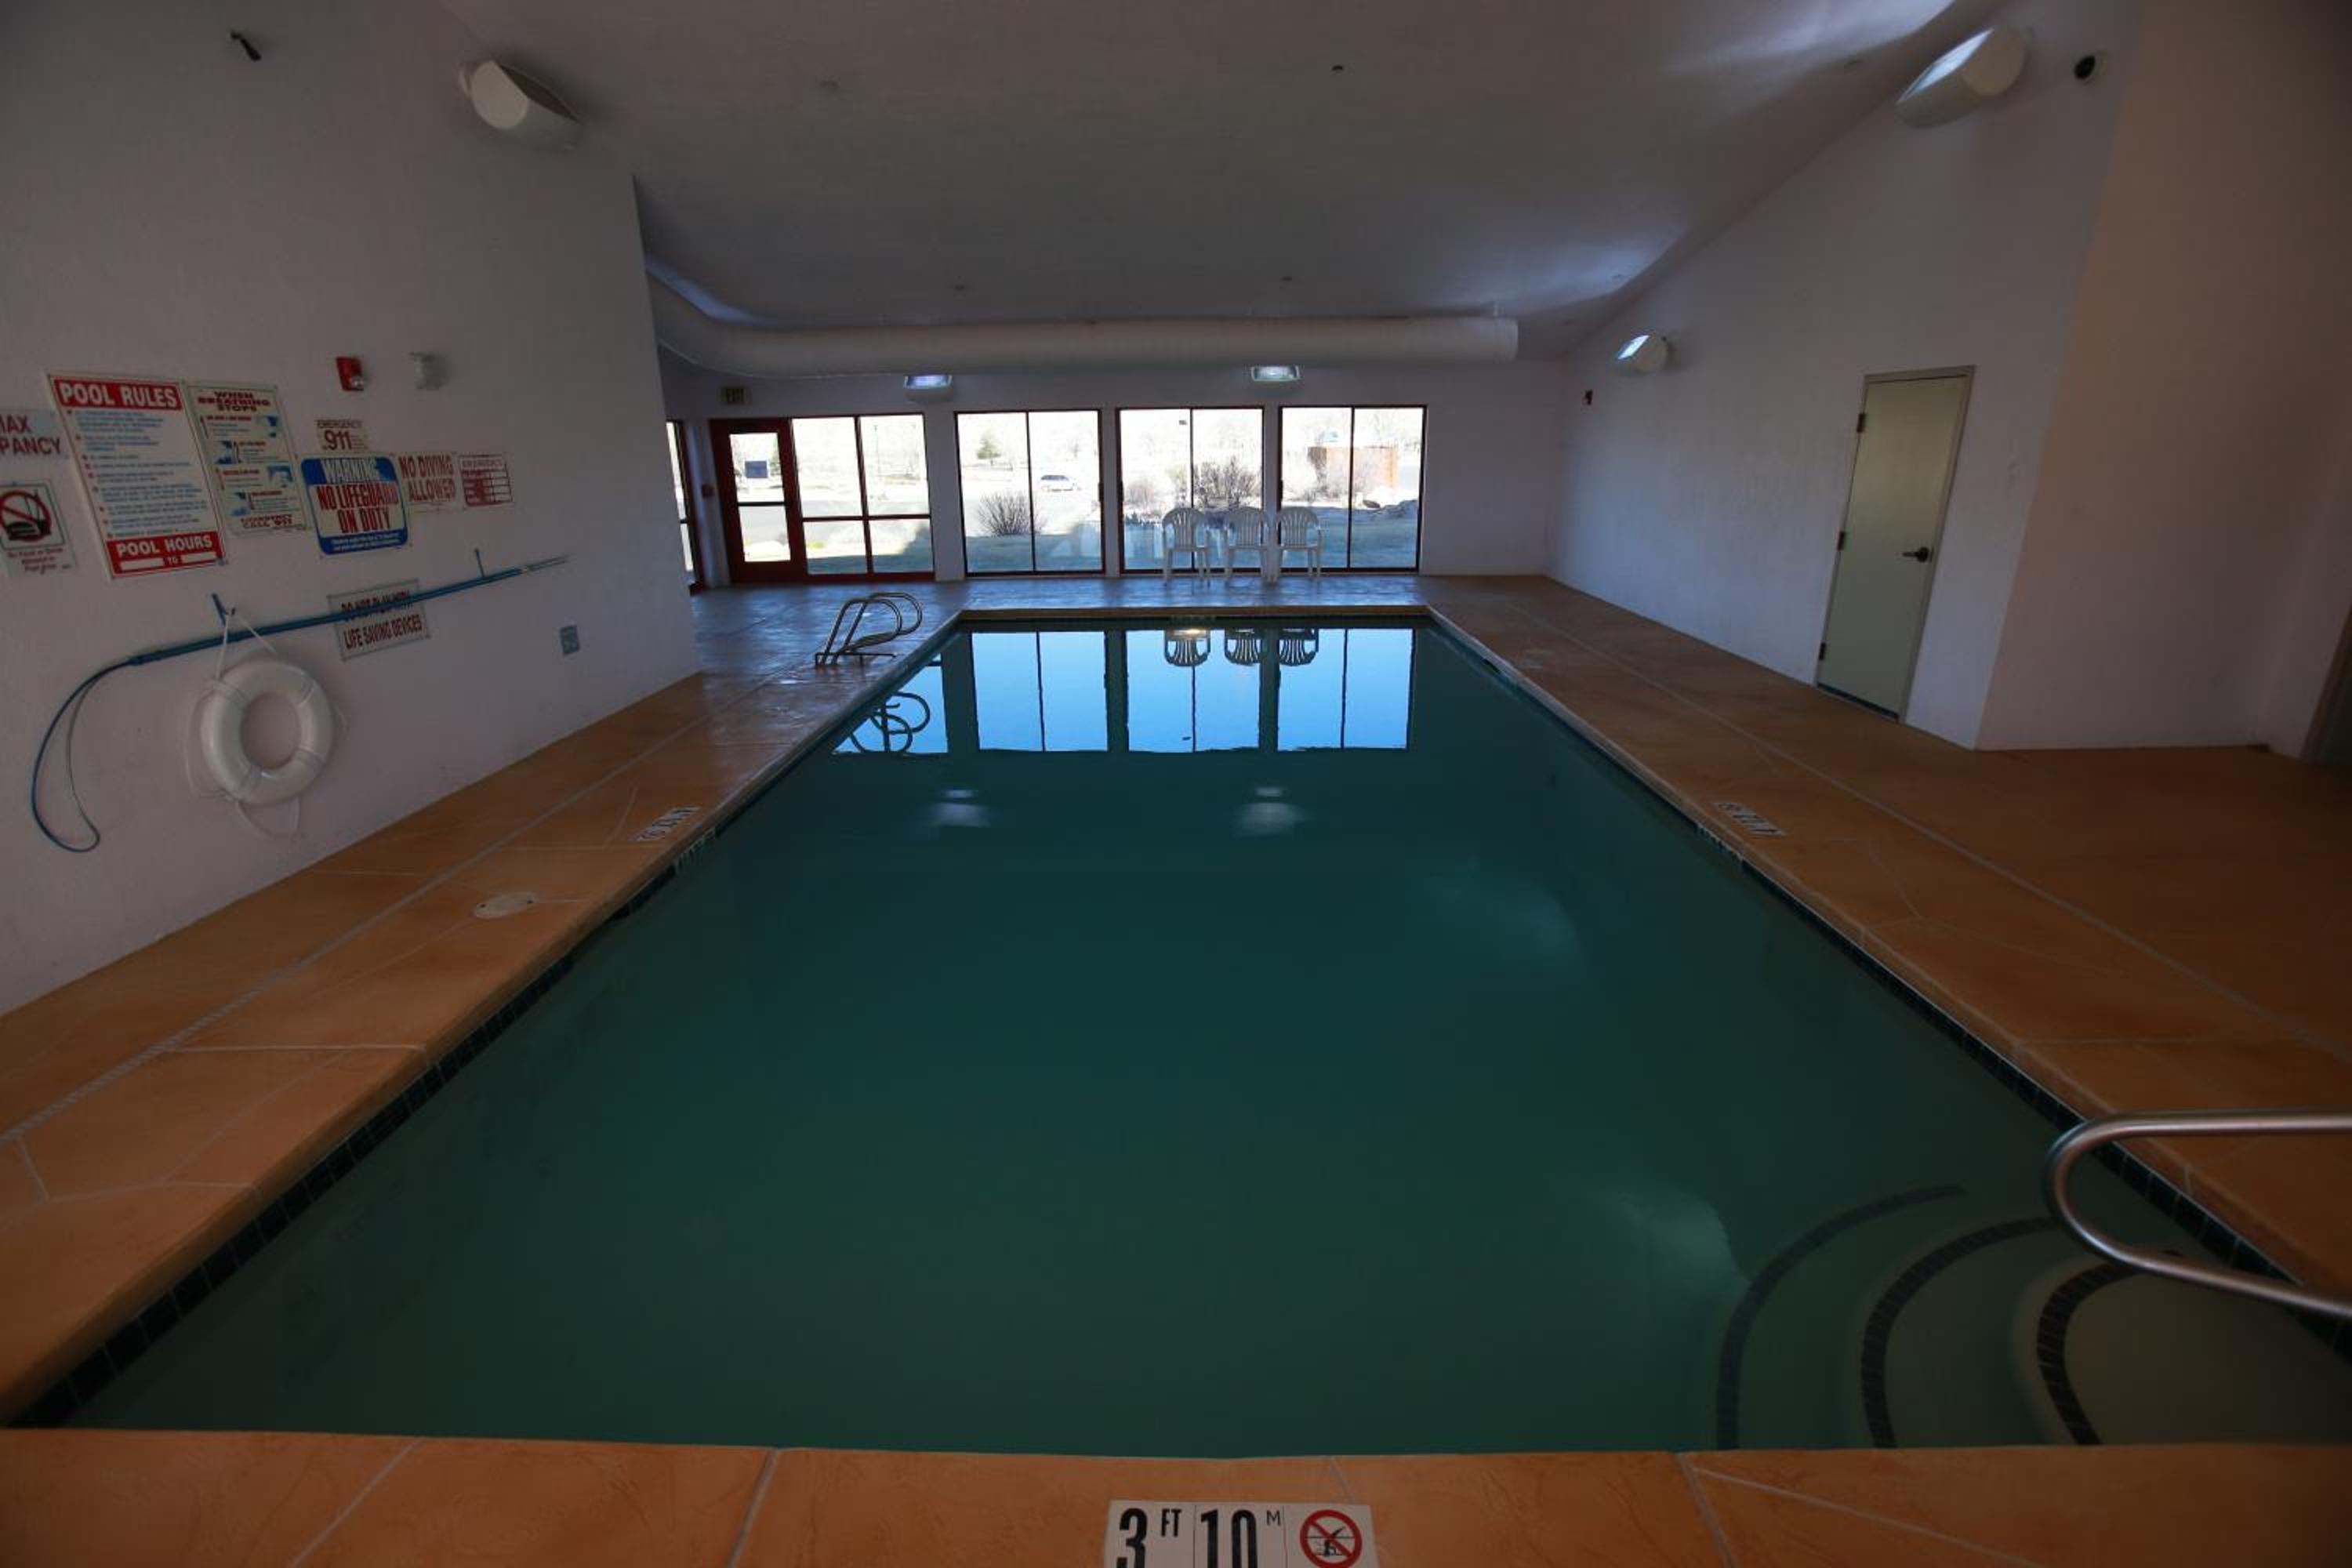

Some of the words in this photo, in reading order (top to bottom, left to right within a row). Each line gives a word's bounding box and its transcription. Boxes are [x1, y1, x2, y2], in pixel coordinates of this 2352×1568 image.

[60, 382, 116, 405] POOL
[119, 386, 179, 408] RULES
[324, 430, 352, 450] 911
[323, 458, 377, 483] WARNING
[398, 456, 416, 478] NO
[416, 454, 455, 477] DIVING
[318, 485, 338, 510] NO
[337, 482, 398, 509] LIFEGUARD
[408, 477, 456, 501] ALLOWED
[337, 509, 358, 533] ON
[358, 506, 390, 532] DUTY
[115, 539, 160, 558] POOL
[164, 535, 212, 552] HOURS
[343, 627, 364, 650] LIFE
[364, 621, 392, 644] SAVING
[390, 613, 423, 637] DEVICES
[1116, 1508, 1148, 1568] 3
[1160, 1508, 1182, 1537] FT
[1266, 1510, 1281, 1526] M
